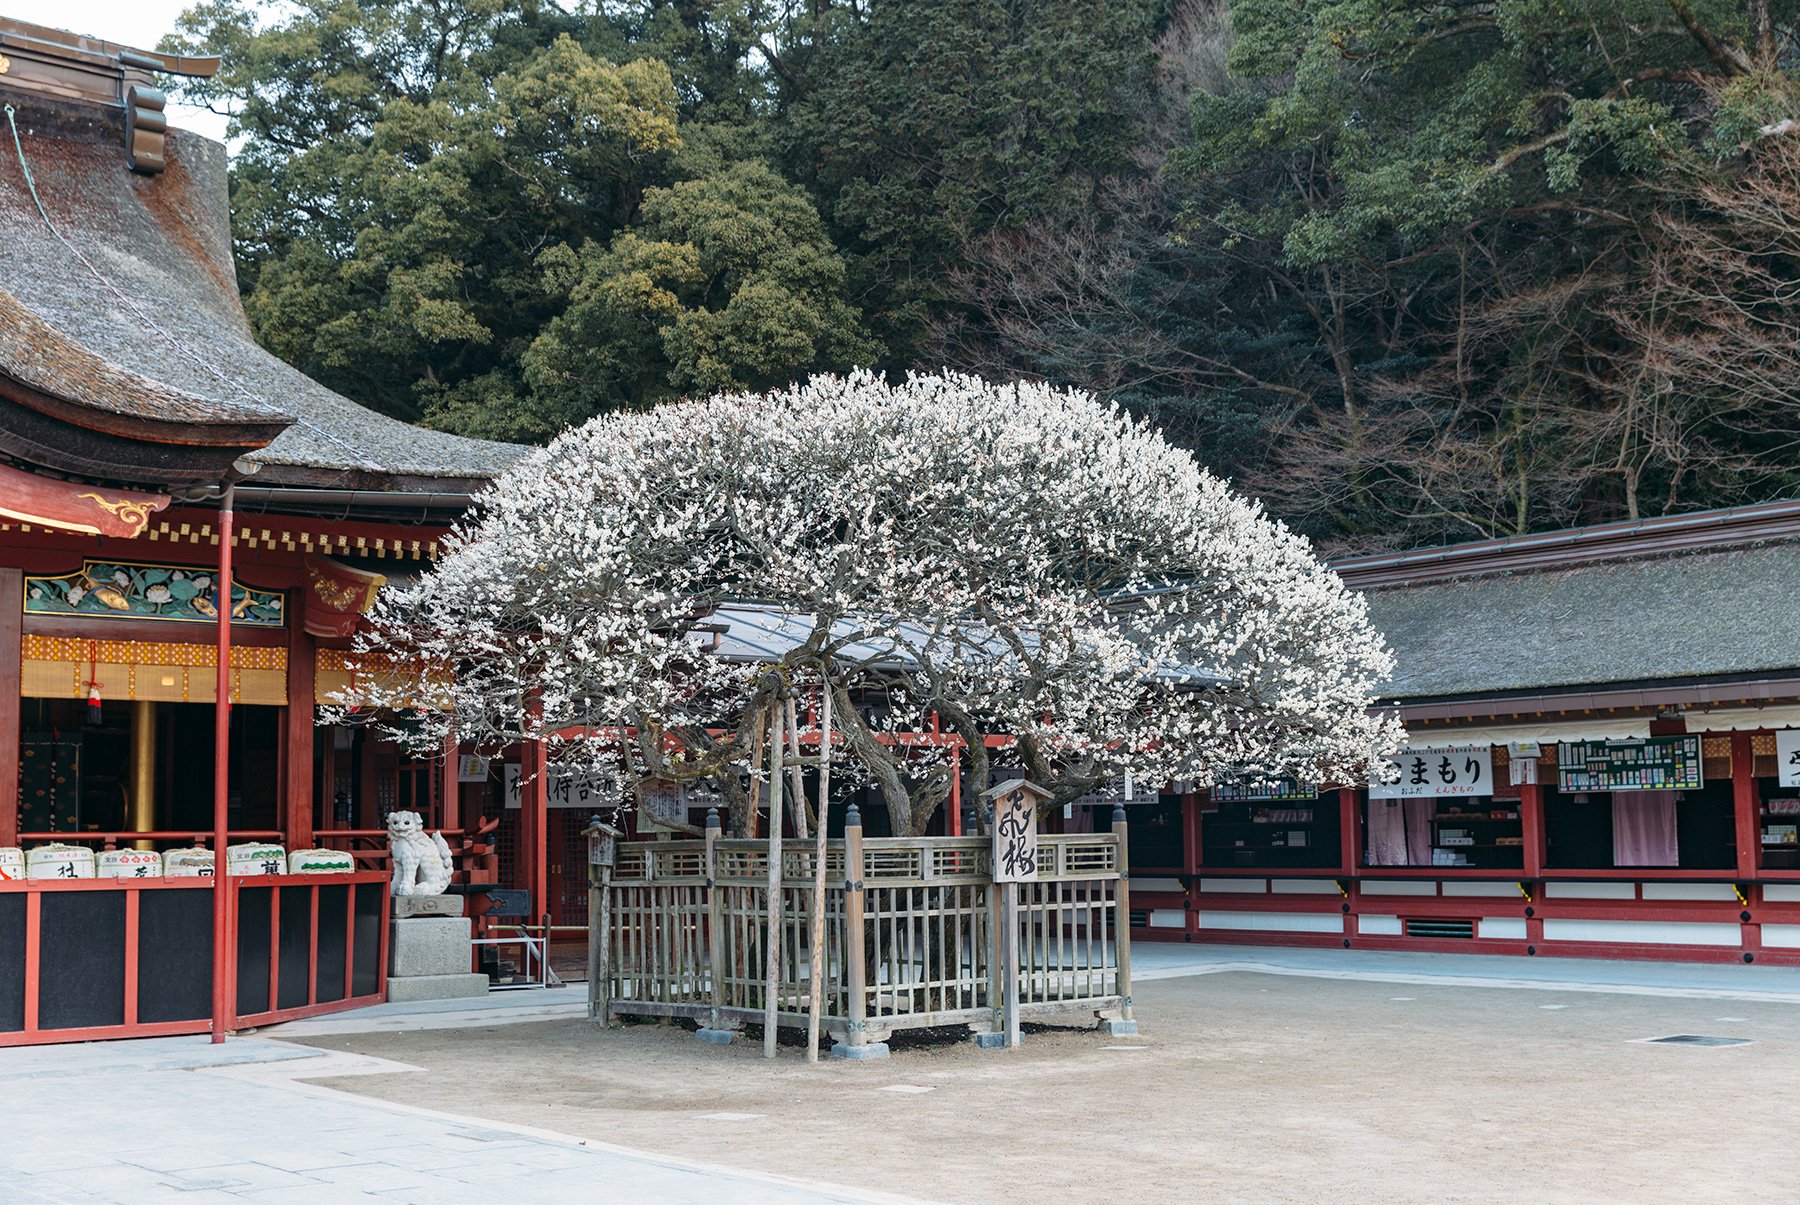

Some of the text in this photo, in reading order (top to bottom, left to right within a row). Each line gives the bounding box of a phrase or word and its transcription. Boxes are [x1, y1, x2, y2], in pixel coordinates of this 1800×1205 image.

[1401, 787, 1423, 795] おふだ
[1435, 786, 1475, 794] えんぎもの
